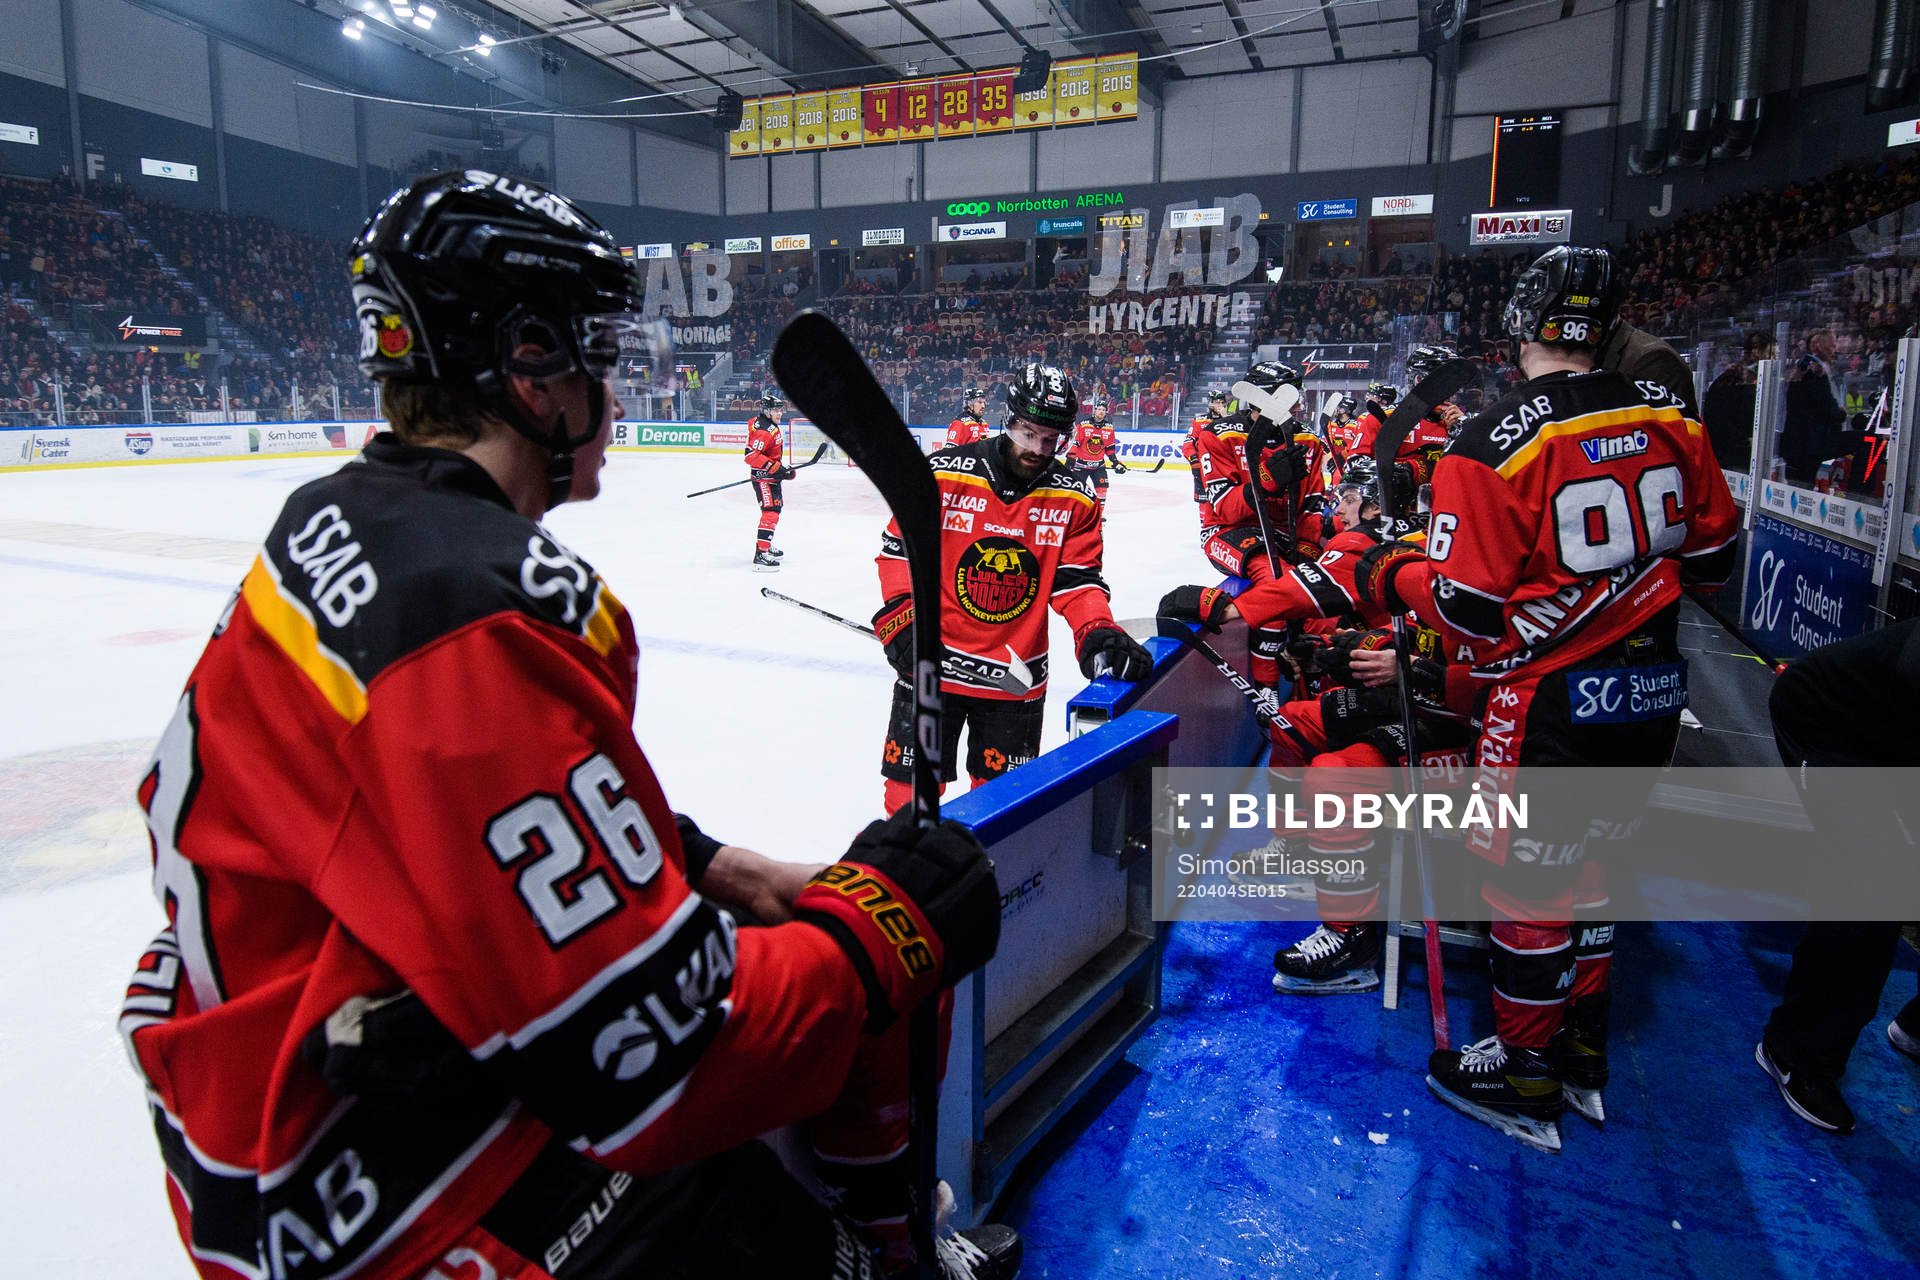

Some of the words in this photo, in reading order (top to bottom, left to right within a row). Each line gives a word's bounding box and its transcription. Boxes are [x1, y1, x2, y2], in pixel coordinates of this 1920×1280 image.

[1060, 80, 1090, 98] 2012
[1102, 75, 1132, 93] 2015
[908, 95, 927, 119] 12
[943, 90, 968, 116] 28
[982, 85, 1007, 111] 35
[800, 111, 823, 126] 2018
[833, 107, 857, 122] 2016
[876, 98, 887, 122] 4
[734, 118, 755, 132] 021
[766, 115, 789, 128] 2019
[86, 152, 104, 180] F
[947, 201, 990, 217] coop
[997, 197, 1068, 213] Norrbotten
[1075, 192, 1124, 208] ARENA
[1383, 199, 1412, 208] NORD
[1649, 184, 1673, 218] J
[1053, 219, 1083, 230] truncatis
[1099, 215, 1143, 228] TITAN
[1478, 216, 1540, 234] MAXI
[962, 226, 996, 237] SCANIA
[775, 237, 806, 249] office
[1089, 192, 1262, 296] JIAB
[642, 249, 733, 318] AB
[1570, 295, 1590, 305] JIAB
[1088, 291, 1251, 336] HYRCENTER
[1562, 321, 1588, 342] 96
[1214, 422, 1244, 434] SSAB
[1489, 395, 1552, 450] SSAB
[35, 437, 71, 448] Svensk
[288, 431, 317, 440] home
[642, 428, 701, 443] Derome
[41, 448, 69, 458] Cater
[752, 440, 765, 451] 88
[929, 456, 977, 471] SSAB
[1051, 473, 1097, 497] SSAB
[951, 495, 988, 512] LKAB
[947, 513, 970, 532] MAX
[984, 523, 1025, 537] SCANIA
[1039, 528, 1060, 544] MAX
[1428, 513, 1458, 561] 6
[288, 504, 379, 628] SSAB
[521, 536, 589, 624] SS
[961, 597, 1031, 621] HOCKEYFÖRENING
[1794, 574, 1843, 628] Student
[879, 607, 915, 641] BAUE
[1457, 645, 1476, 662] A
[1217, 661, 1293, 731] BAUER
[1630, 688, 1688, 713] Consultin
[487, 754, 662, 947] 26
[544, 1169, 634, 1275] BAUE
